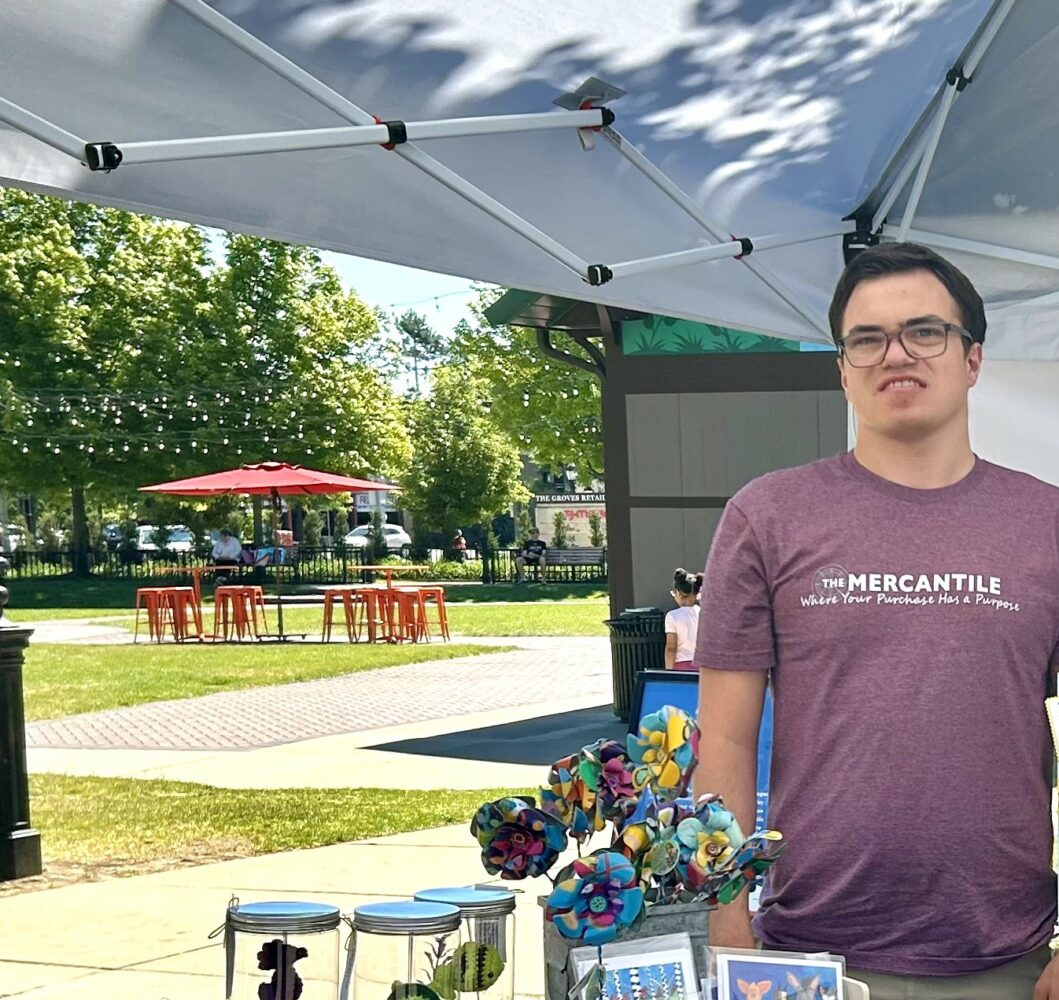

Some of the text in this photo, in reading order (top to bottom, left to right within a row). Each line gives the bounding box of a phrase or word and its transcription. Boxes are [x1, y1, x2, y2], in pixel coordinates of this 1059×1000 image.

[536, 494, 550, 502] THE
[551, 494, 580, 502] GROVES
[822, 573, 1001, 595] THE MERCANTILE
[801, 591, 1020, 611] Where Your Purchase Has a Purpose
